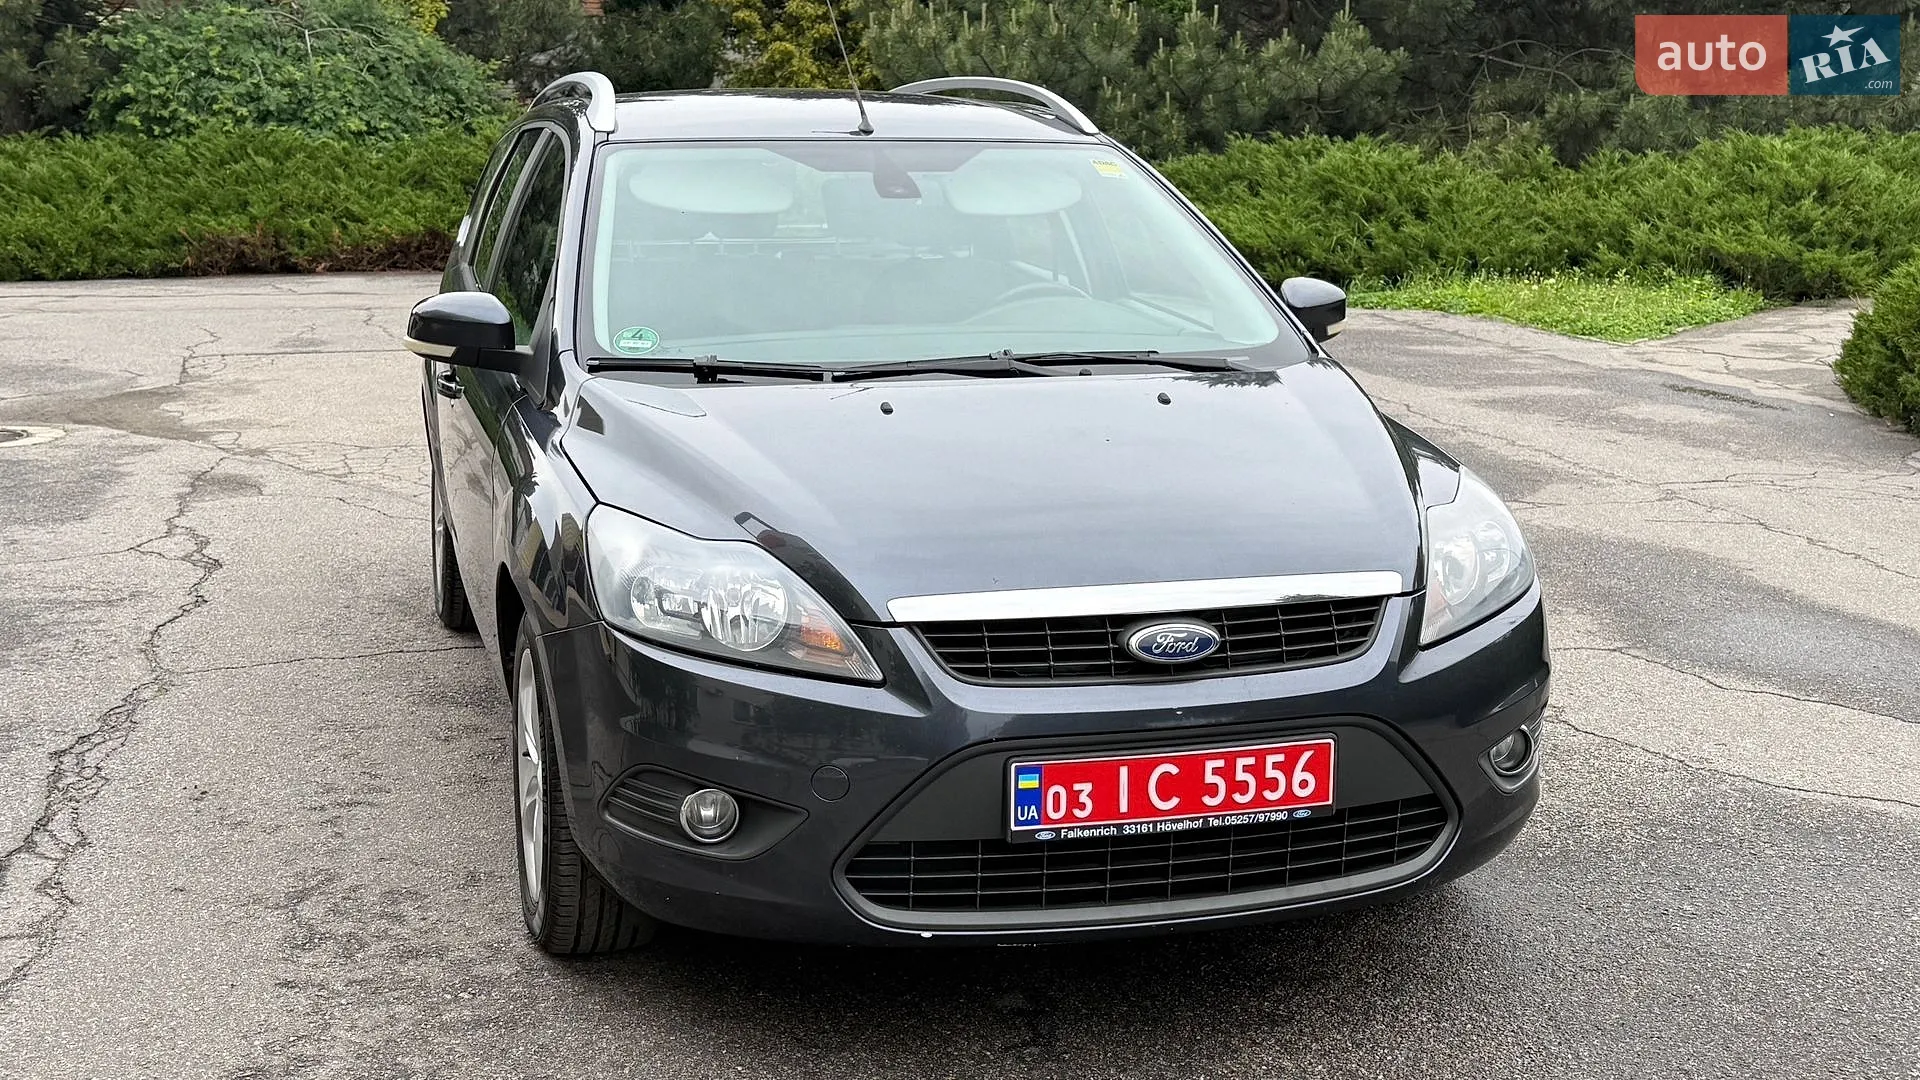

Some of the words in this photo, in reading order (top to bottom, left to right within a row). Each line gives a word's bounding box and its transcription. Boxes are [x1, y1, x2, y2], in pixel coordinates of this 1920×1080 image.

[631, 328, 644, 341] 4
[1152, 632, 1199, 654] Ford
[1046, 782, 1093, 820] 03
[1201, 750, 1316, 807] 5556
[1017, 805, 1039, 820] UA
[1060, 826, 1117, 839] Falkenrich
[1122, 822, 1154, 835] 33161
[1156, 817, 1204, 832] Hövelhof
